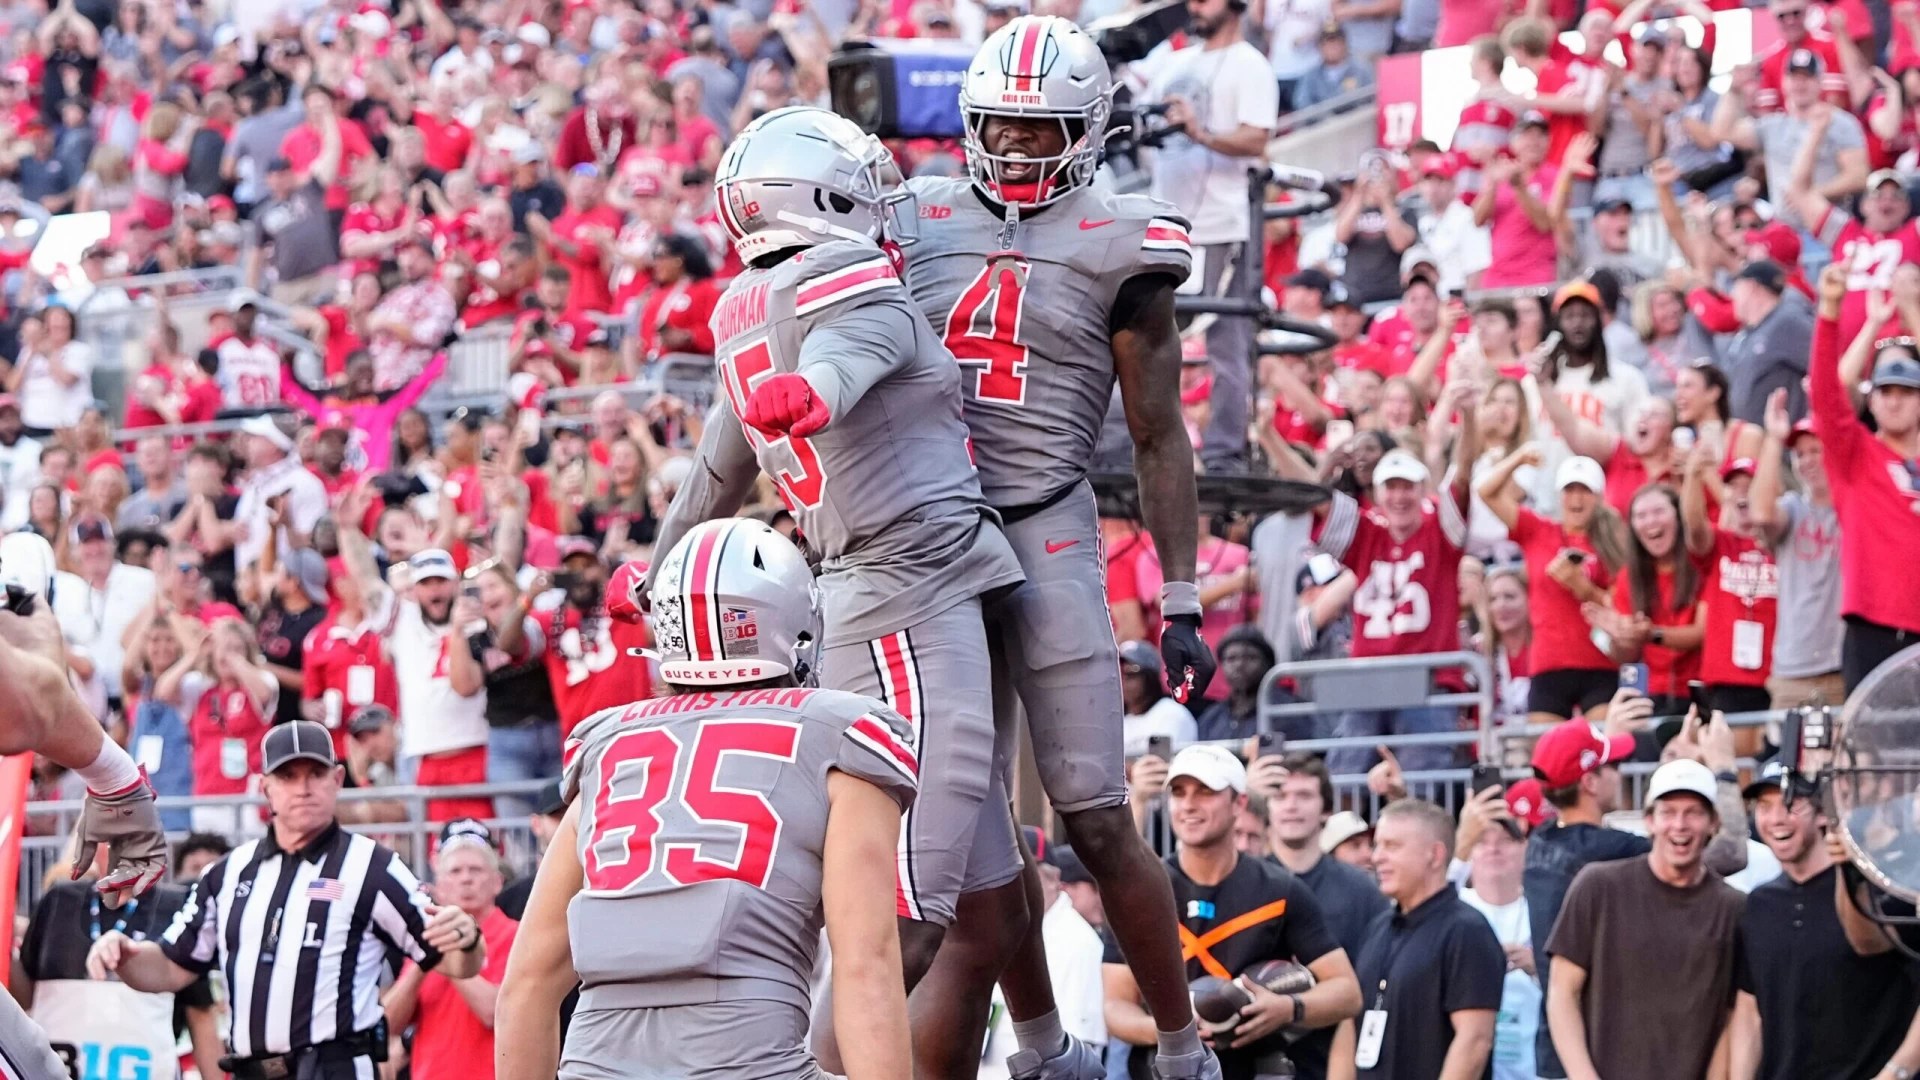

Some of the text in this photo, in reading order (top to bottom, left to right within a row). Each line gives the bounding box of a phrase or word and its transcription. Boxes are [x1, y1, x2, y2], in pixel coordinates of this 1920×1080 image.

[1002, 94, 1041, 105] OHIO STATE
[941, 262, 1033, 406] 4
[1353, 551, 1431, 639] 45
[722, 611, 736, 623] 85
[664, 667, 761, 680] BUCKEYES
[619, 687, 815, 722] CHRISTIAN
[583, 718, 803, 893] 85
[302, 922, 322, 947] L
